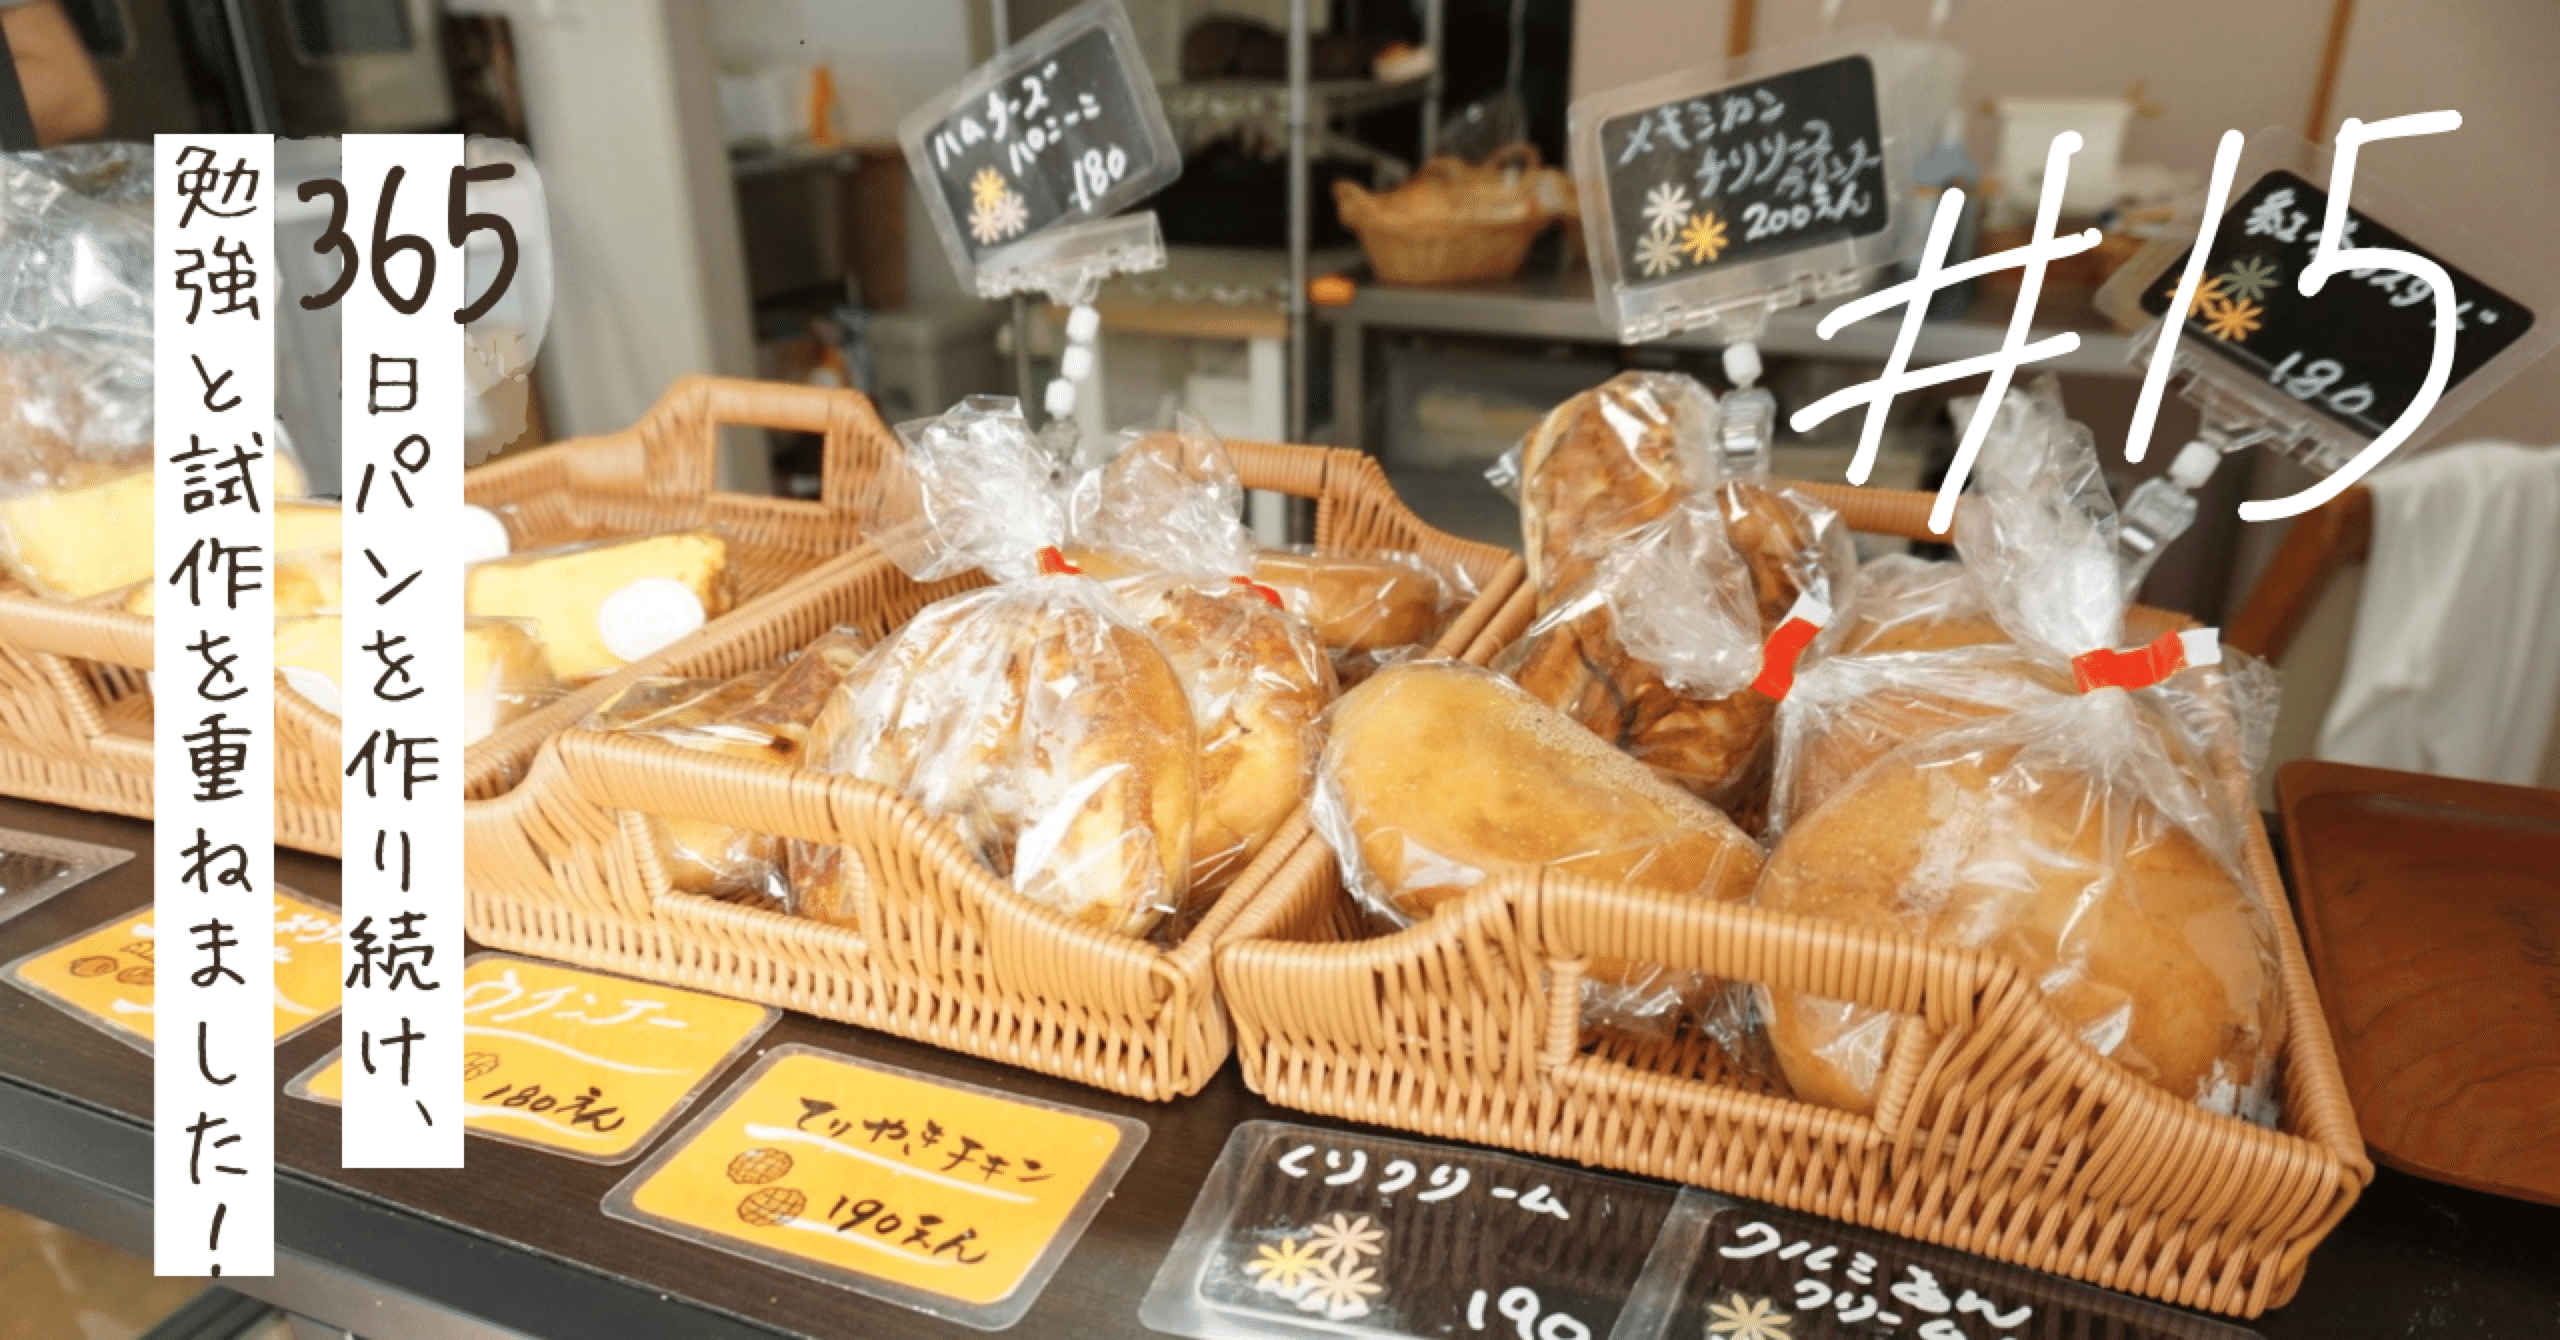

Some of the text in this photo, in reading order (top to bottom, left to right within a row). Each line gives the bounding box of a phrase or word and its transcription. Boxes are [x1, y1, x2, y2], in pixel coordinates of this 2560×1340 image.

[935, 61, 1058, 171] ハムチーズ
[1070, 143, 1127, 212] 180
[1742, 180, 1873, 240] 200えん
[2269, 352, 2374, 414] 180
[481, 1084, 626, 1132] 180えん
[795, 1097, 1056, 1183] てりやきチキン
[1278, 1145, 1571, 1220] くりクリーム
[827, 1195, 989, 1265] 190えん
